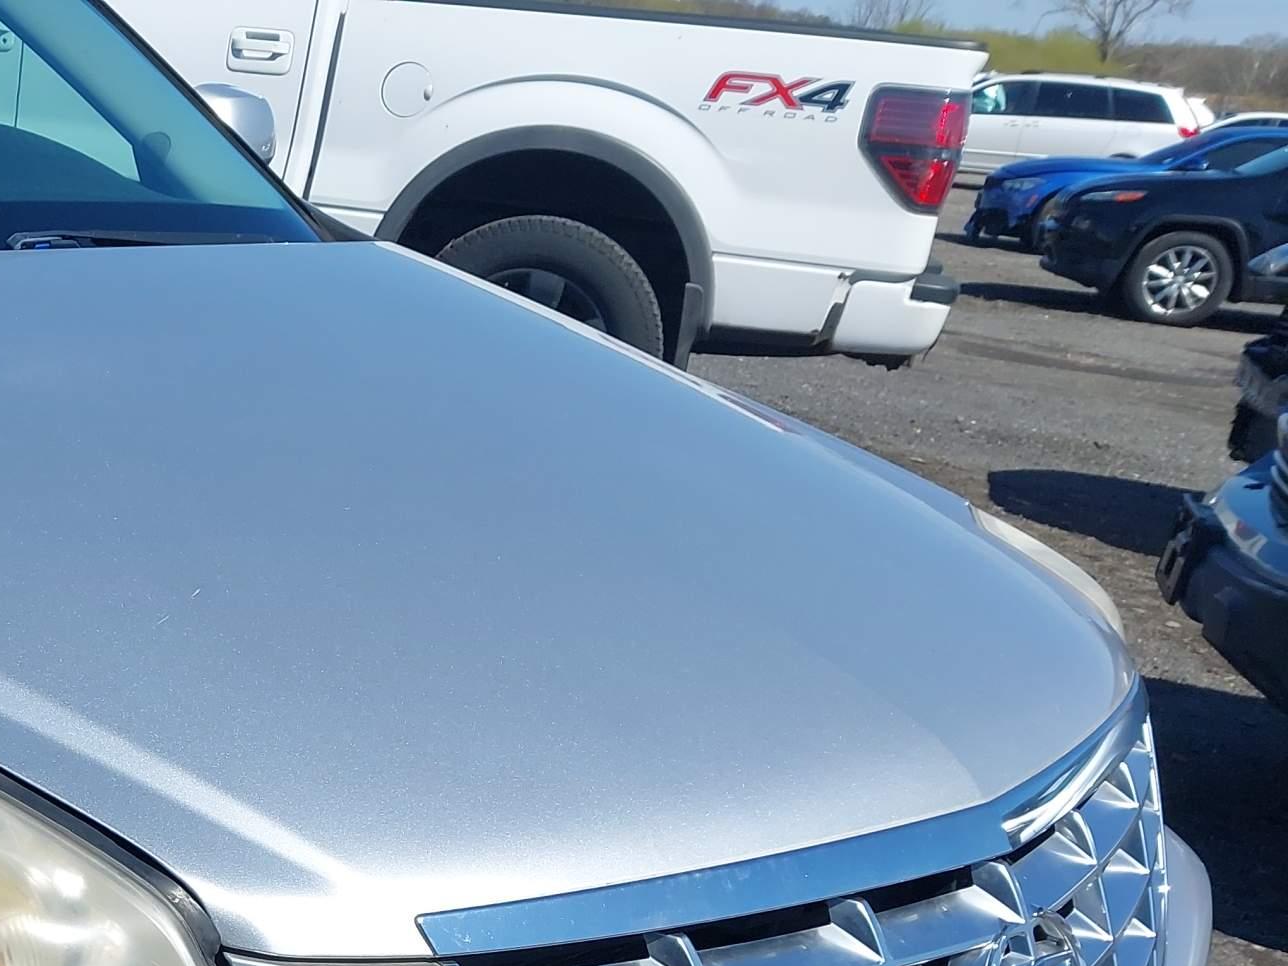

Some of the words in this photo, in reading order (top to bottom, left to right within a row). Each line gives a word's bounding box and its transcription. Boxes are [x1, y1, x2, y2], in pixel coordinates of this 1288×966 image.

[703, 71, 856, 112] FX4
[698, 104, 749, 113] OFF
[763, 111, 839, 123] ROAD
